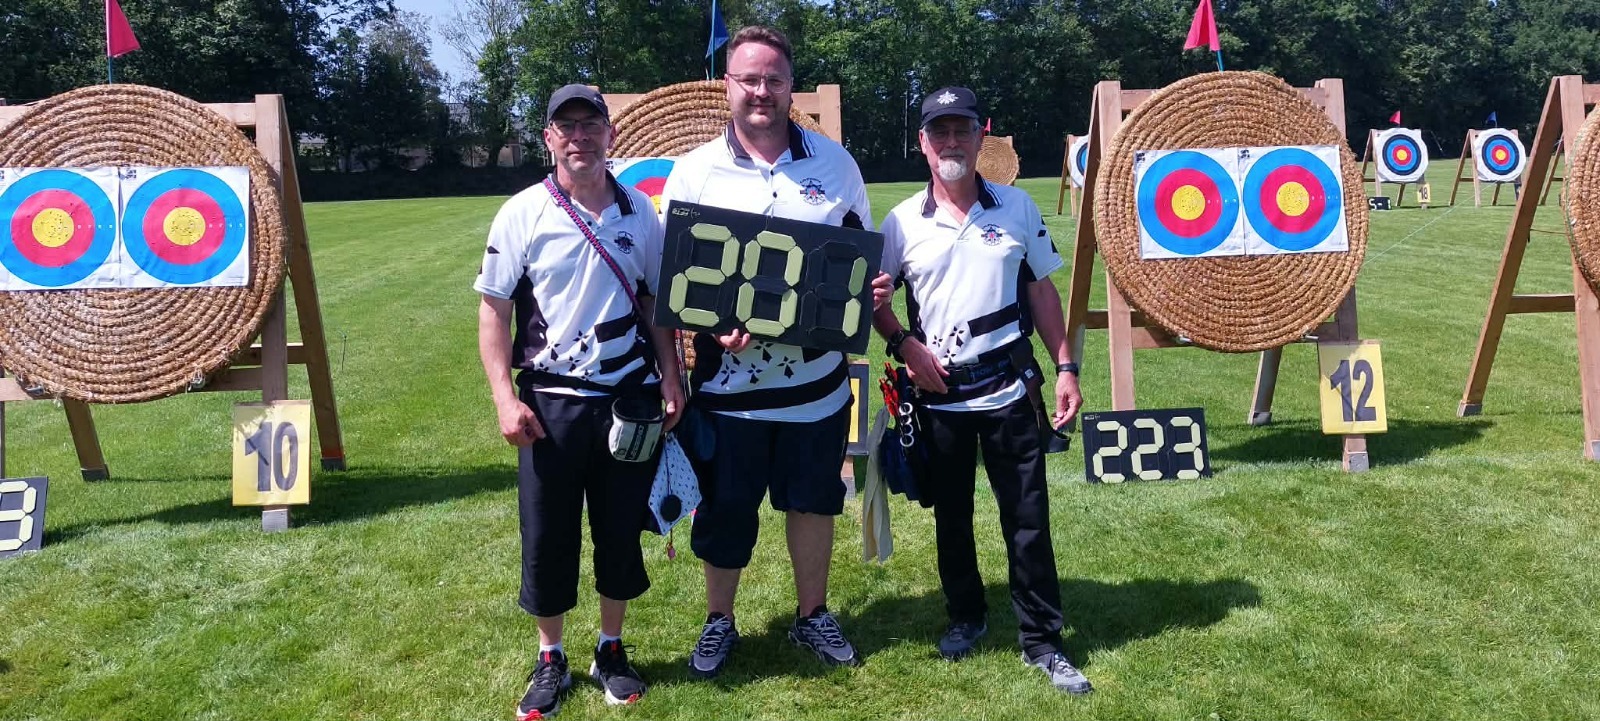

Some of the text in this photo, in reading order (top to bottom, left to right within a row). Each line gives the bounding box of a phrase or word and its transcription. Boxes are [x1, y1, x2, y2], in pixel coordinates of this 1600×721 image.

[1419, 187, 1429, 200] 18
[669, 222, 868, 338] 201
[1330, 359, 1377, 422] 12
[245, 421, 299, 492] 10
[1092, 416, 1205, 484] 223
